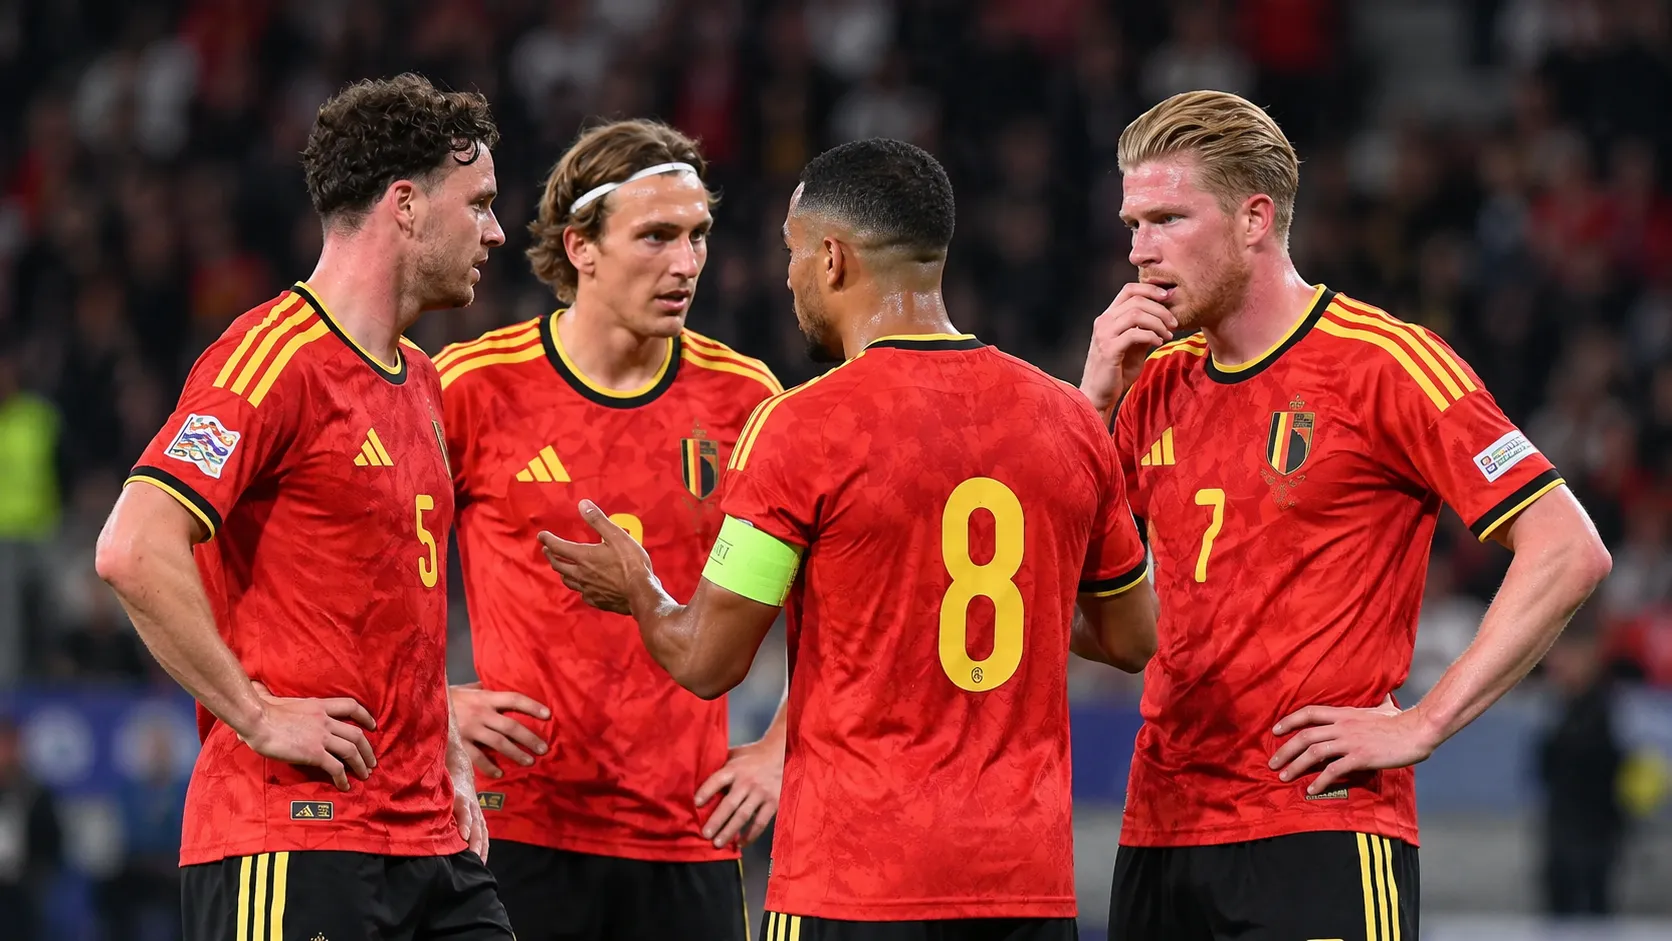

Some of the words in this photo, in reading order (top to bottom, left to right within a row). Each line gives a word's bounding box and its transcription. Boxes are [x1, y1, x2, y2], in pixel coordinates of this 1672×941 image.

[415, 494, 438, 588] 5
[1194, 488, 1226, 583] 7
[938, 477, 1025, 692] 8
